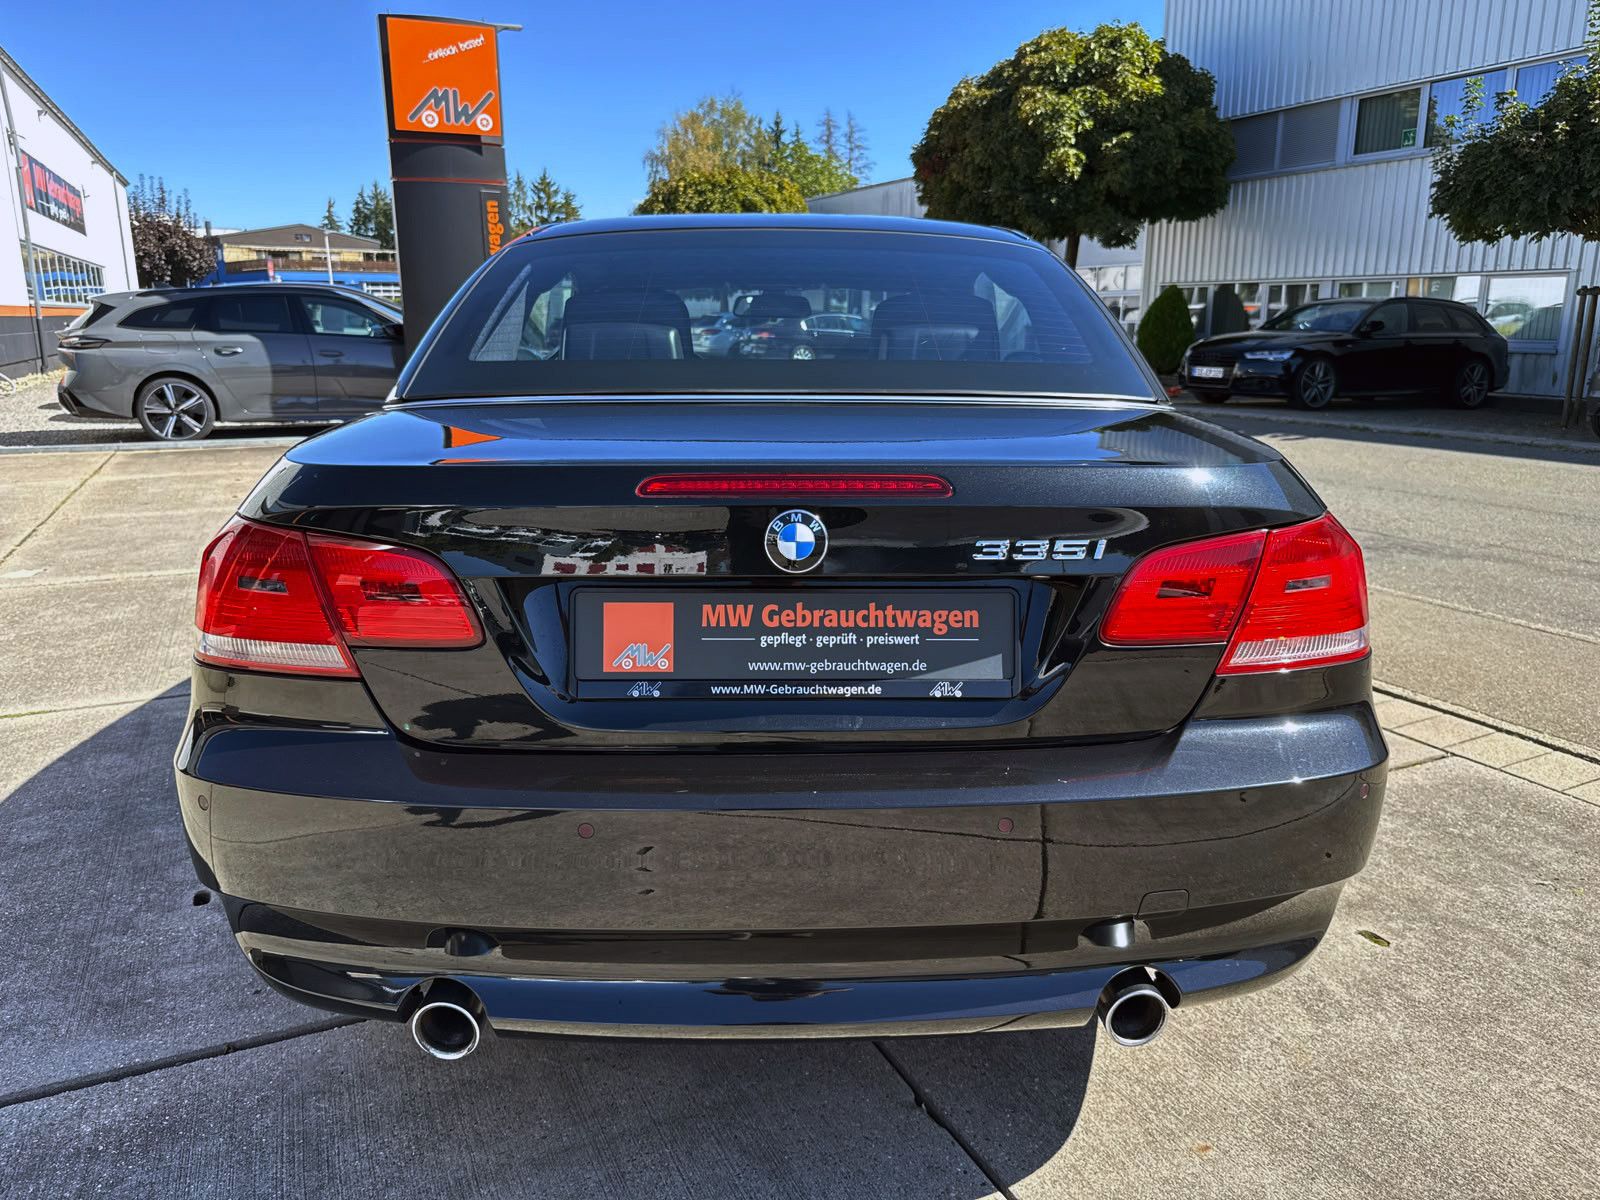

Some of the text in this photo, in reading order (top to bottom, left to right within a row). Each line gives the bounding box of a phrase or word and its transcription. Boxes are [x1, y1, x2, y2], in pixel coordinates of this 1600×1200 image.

[408, 87, 495, 131] MW
[972, 539, 1108, 561] 335i
[701, 602, 980, 636] MW Gebrauchtwagen
[760, 632, 920, 648] gepflegt geprüft preiswert
[612, 643, 671, 670] MW
[748, 659, 927, 674] www.mw-gebrauchtwagen.de
[710, 684, 882, 697] www.MW-Gebrauchtwagen.de
